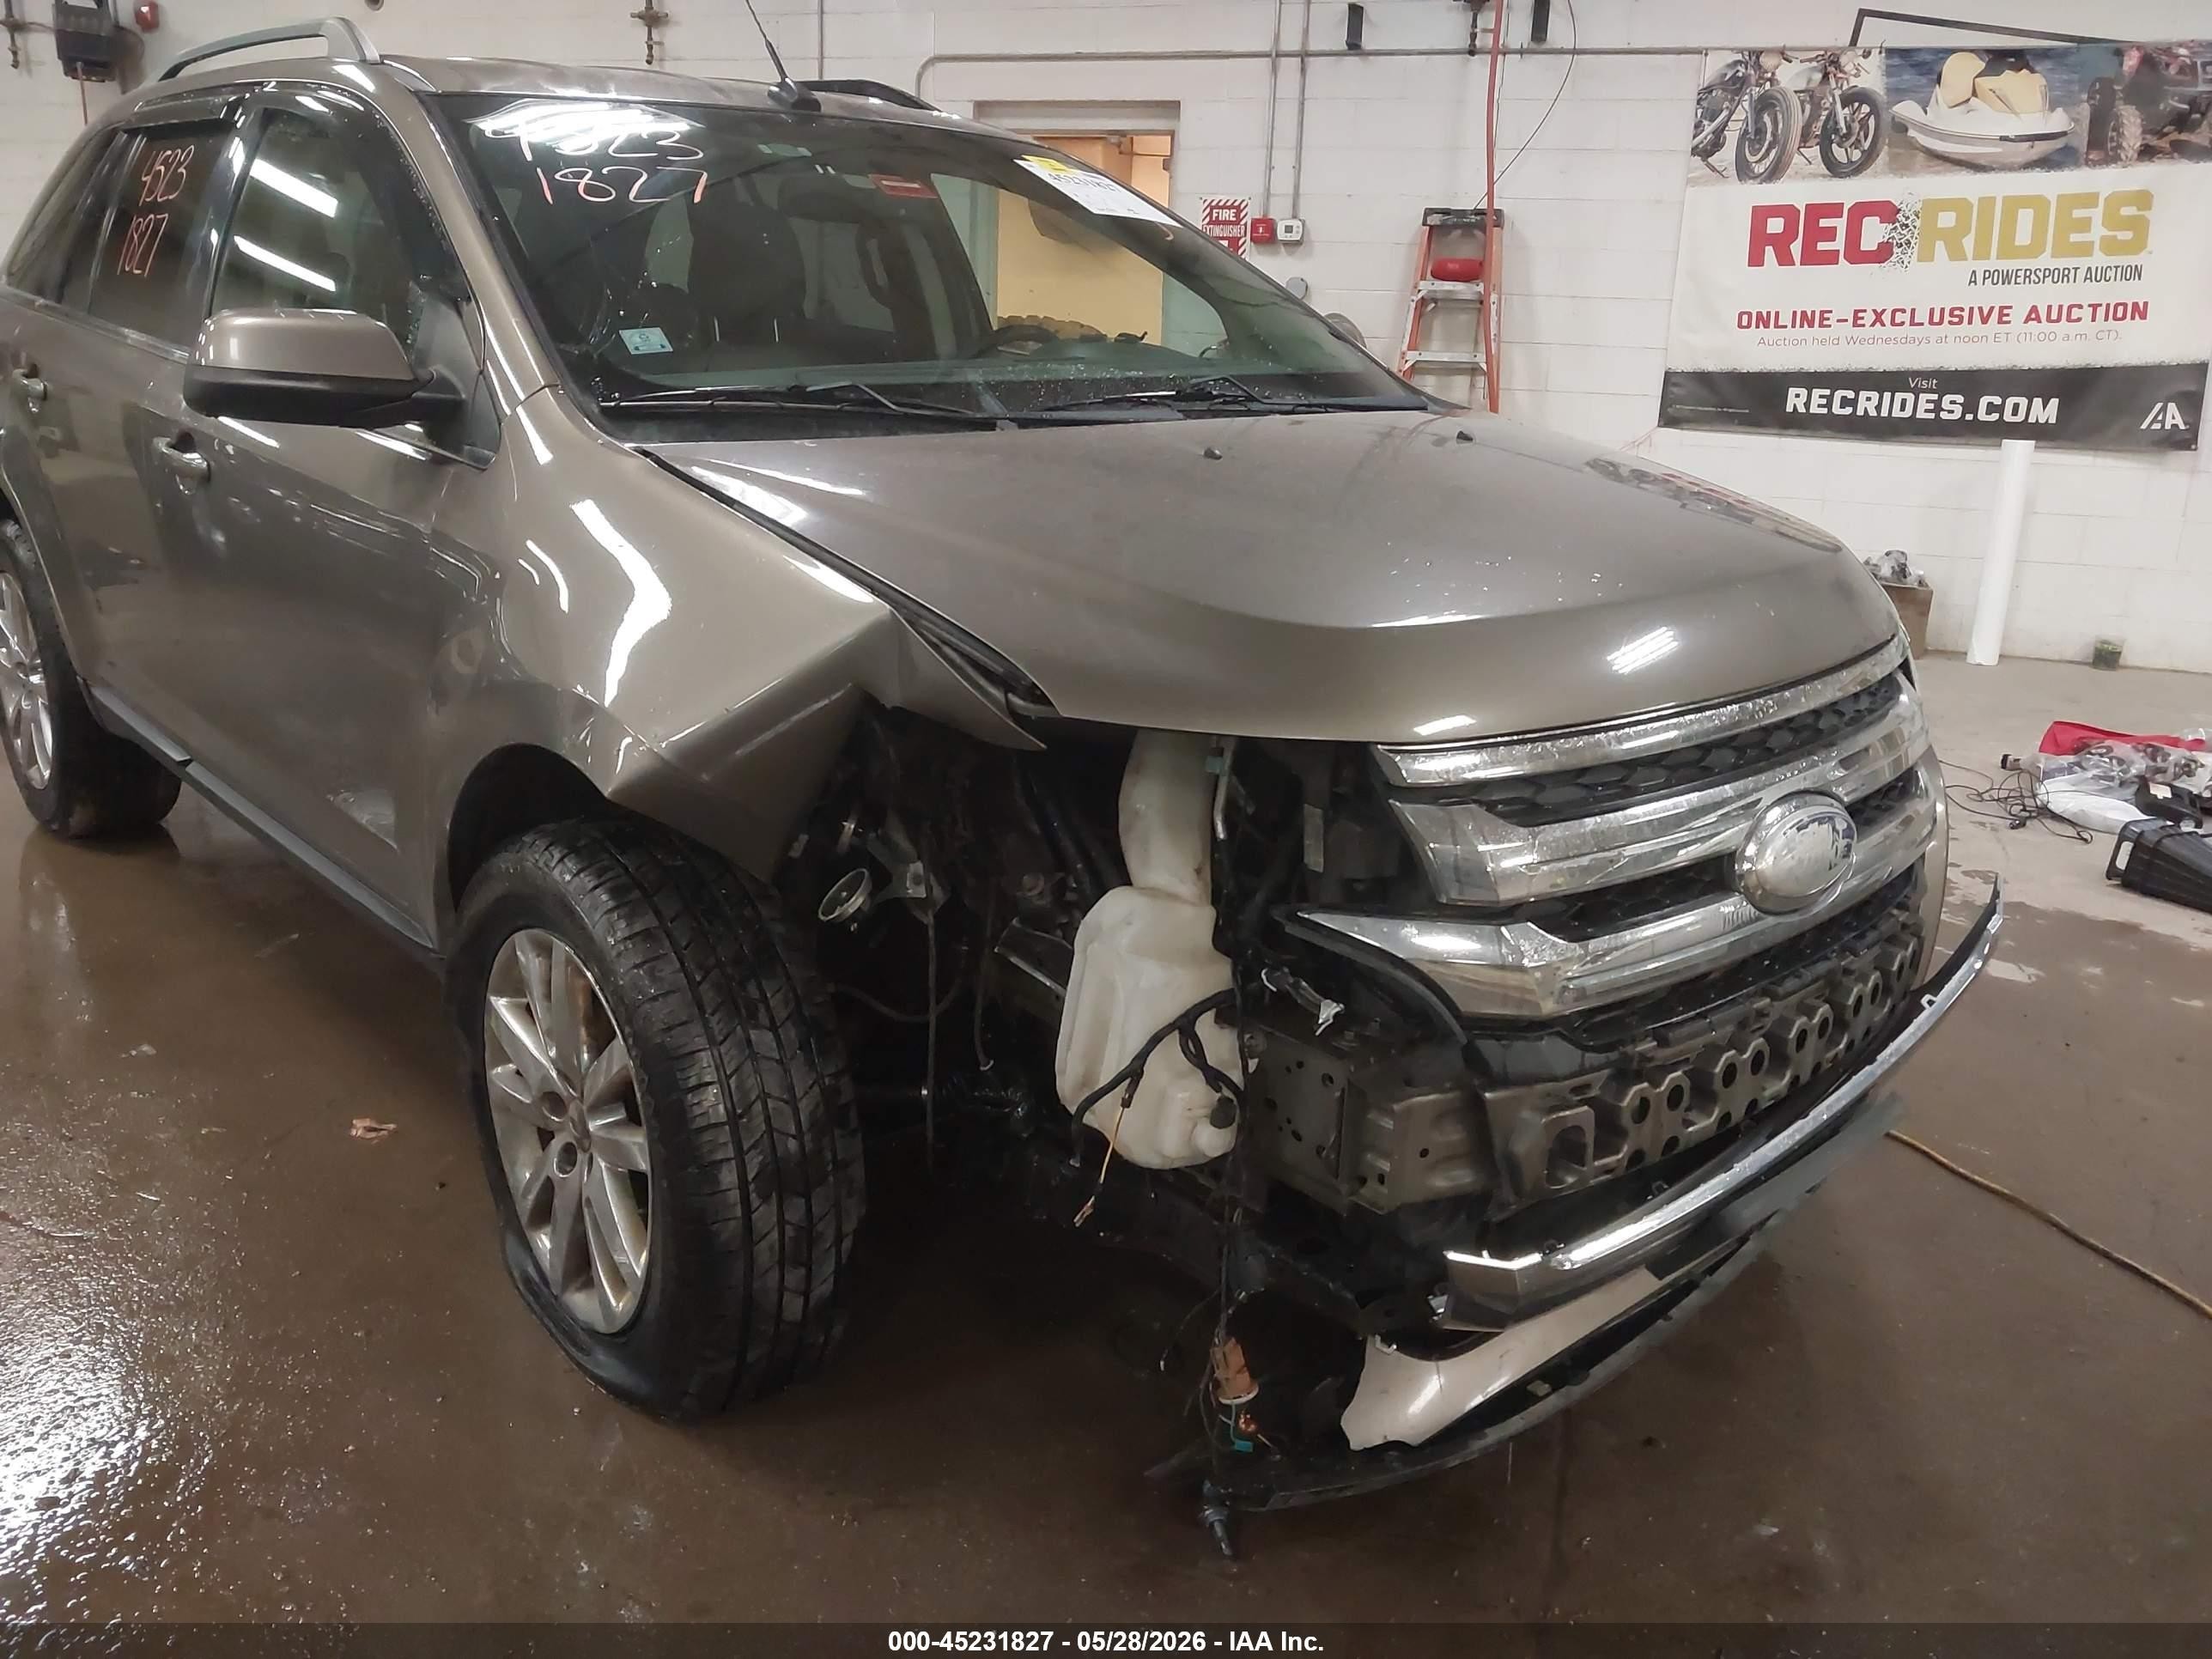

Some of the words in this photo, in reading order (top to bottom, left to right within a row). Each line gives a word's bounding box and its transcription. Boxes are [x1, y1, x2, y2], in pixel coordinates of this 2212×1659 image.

[138, 145, 195, 206] 4523
[536, 166, 708, 204] 1827
[1212, 208, 1237, 222] FIRE
[1747, 199, 1901, 268] REC
[1917, 188, 2155, 263] RIDES
[117, 213, 169, 277] 1827
[1202, 224, 1245, 238] EXTINGUISHER
[1968, 269, 1978, 287] A
[1982, 266, 2081, 286] POWERSPORT
[2083, 264, 2143, 283] AUCTION
[1736, 305, 2014, 330] ONLINE-EXCLUSIVE
[2023, 301, 2149, 325] AUCTION
[1757, 336, 1808, 347] Auction
[1812, 335, 1840, 346] held
[1845, 333, 1931, 346] Wednesdays
[1936, 333, 1948, 344] at
[1954, 334, 1989, 344] noon
[1993, 331, 2013, 343] ET
[2016, 330, 2057, 343] (11:00
[2062, 331, 2092, 342] a.m.
[1908, 377, 1938, 389] Visit
[1785, 387, 2060, 424] RECRIDES.COM
